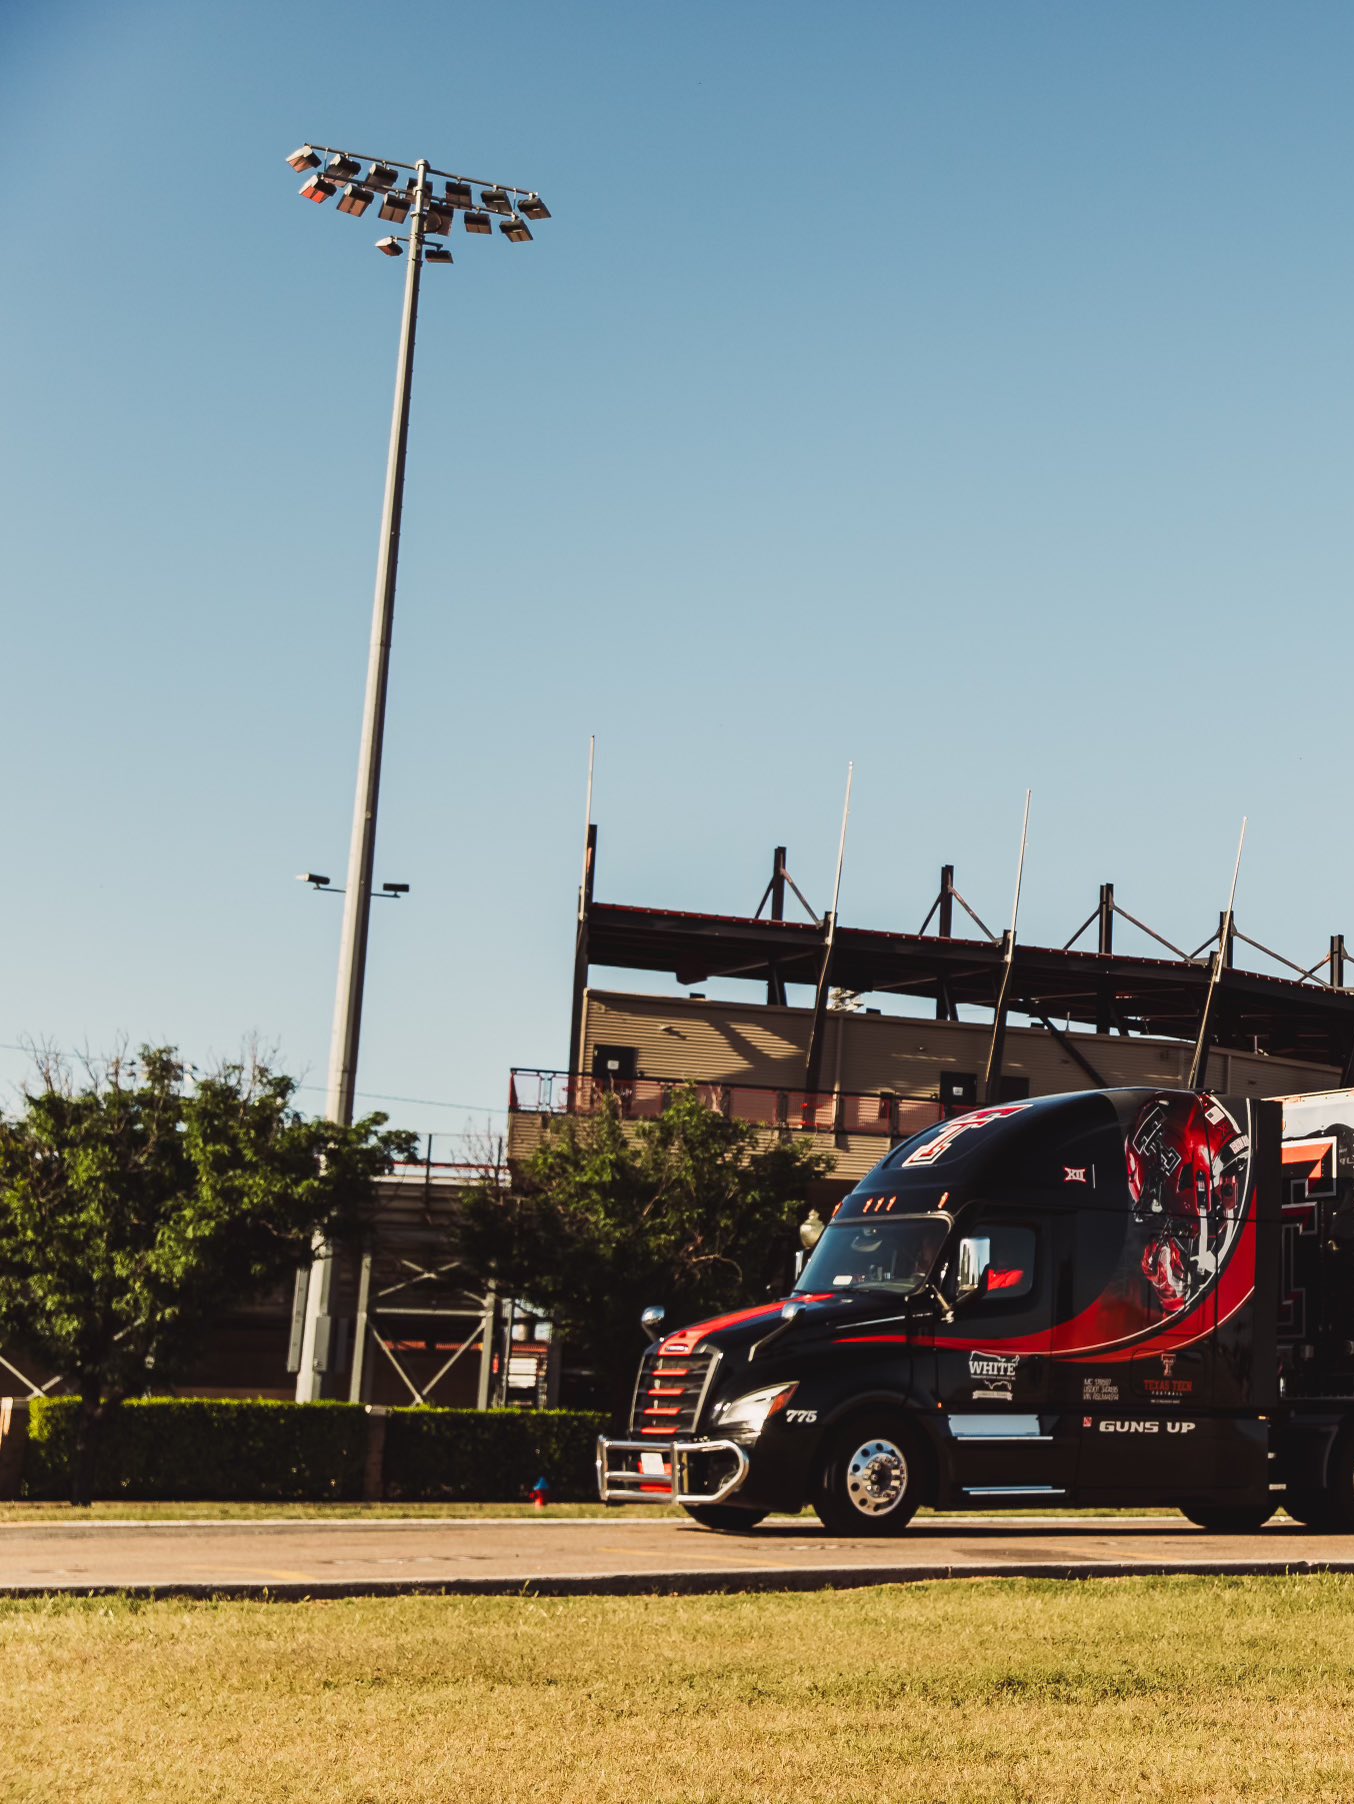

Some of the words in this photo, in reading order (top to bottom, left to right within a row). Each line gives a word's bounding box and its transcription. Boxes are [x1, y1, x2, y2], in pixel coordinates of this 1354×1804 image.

[969, 1361, 1016, 1376] WHITE
[1143, 1379, 1170, 1391] TEXAS
[1172, 1379, 1193, 1392] TECH
[785, 1409, 818, 1423] 775
[1099, 1421, 1160, 1433] GUNS
[1166, 1421, 1196, 1434] UP
